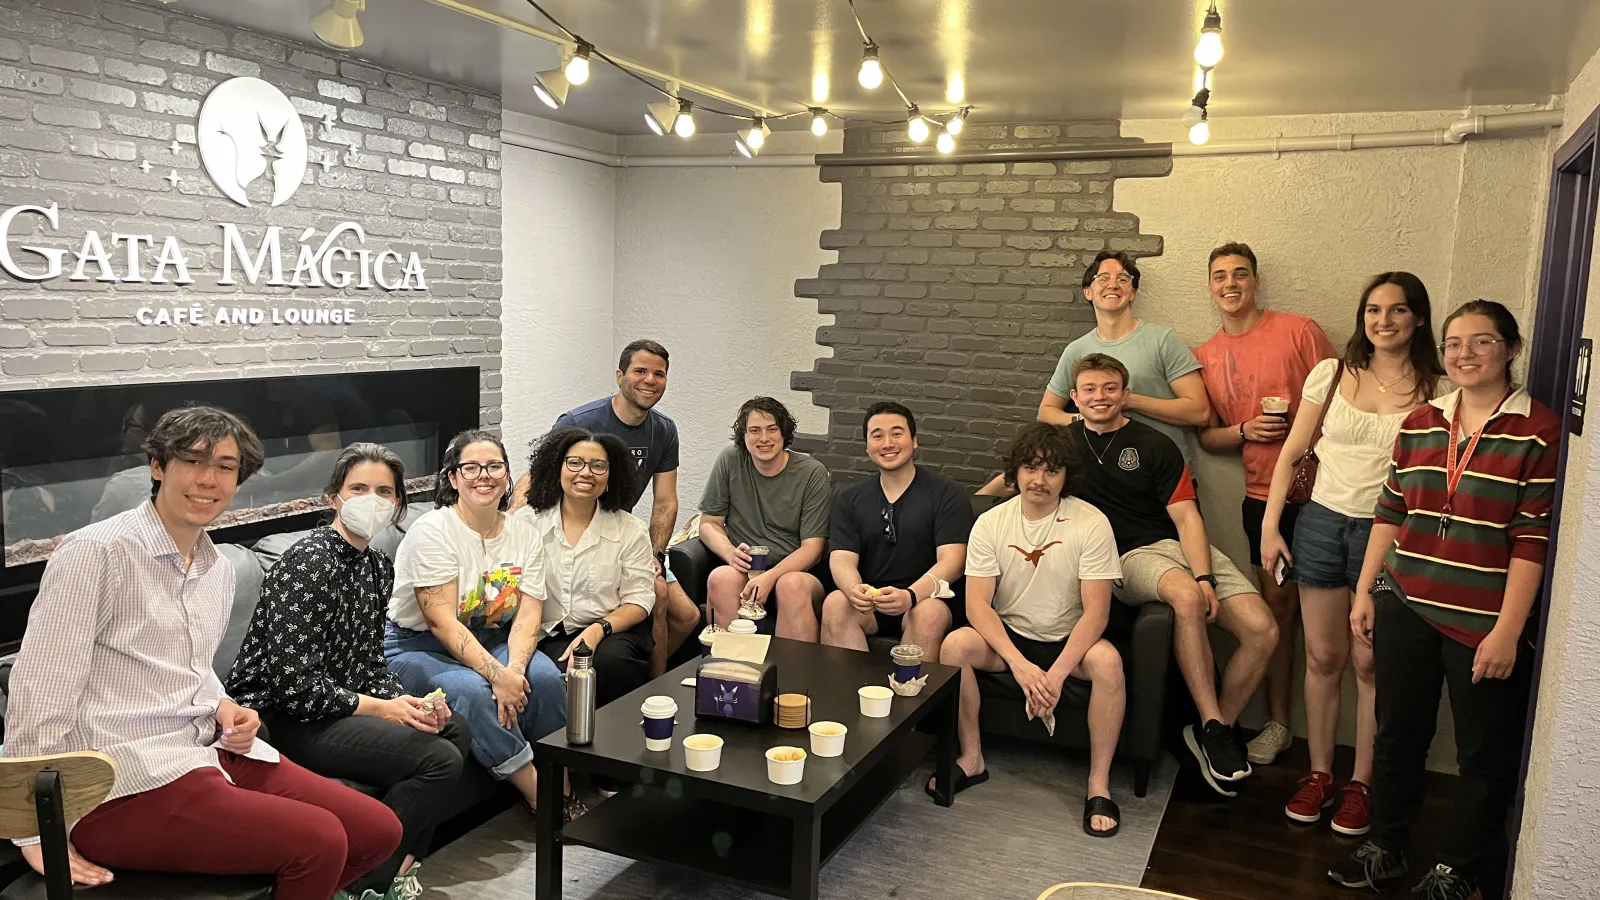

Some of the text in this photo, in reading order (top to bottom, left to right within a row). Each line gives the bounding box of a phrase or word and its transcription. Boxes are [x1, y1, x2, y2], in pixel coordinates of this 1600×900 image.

[0, 202, 429, 290] GATA MÁGICA
[136, 302, 356, 325] CAFÉ AND LOUNGE
